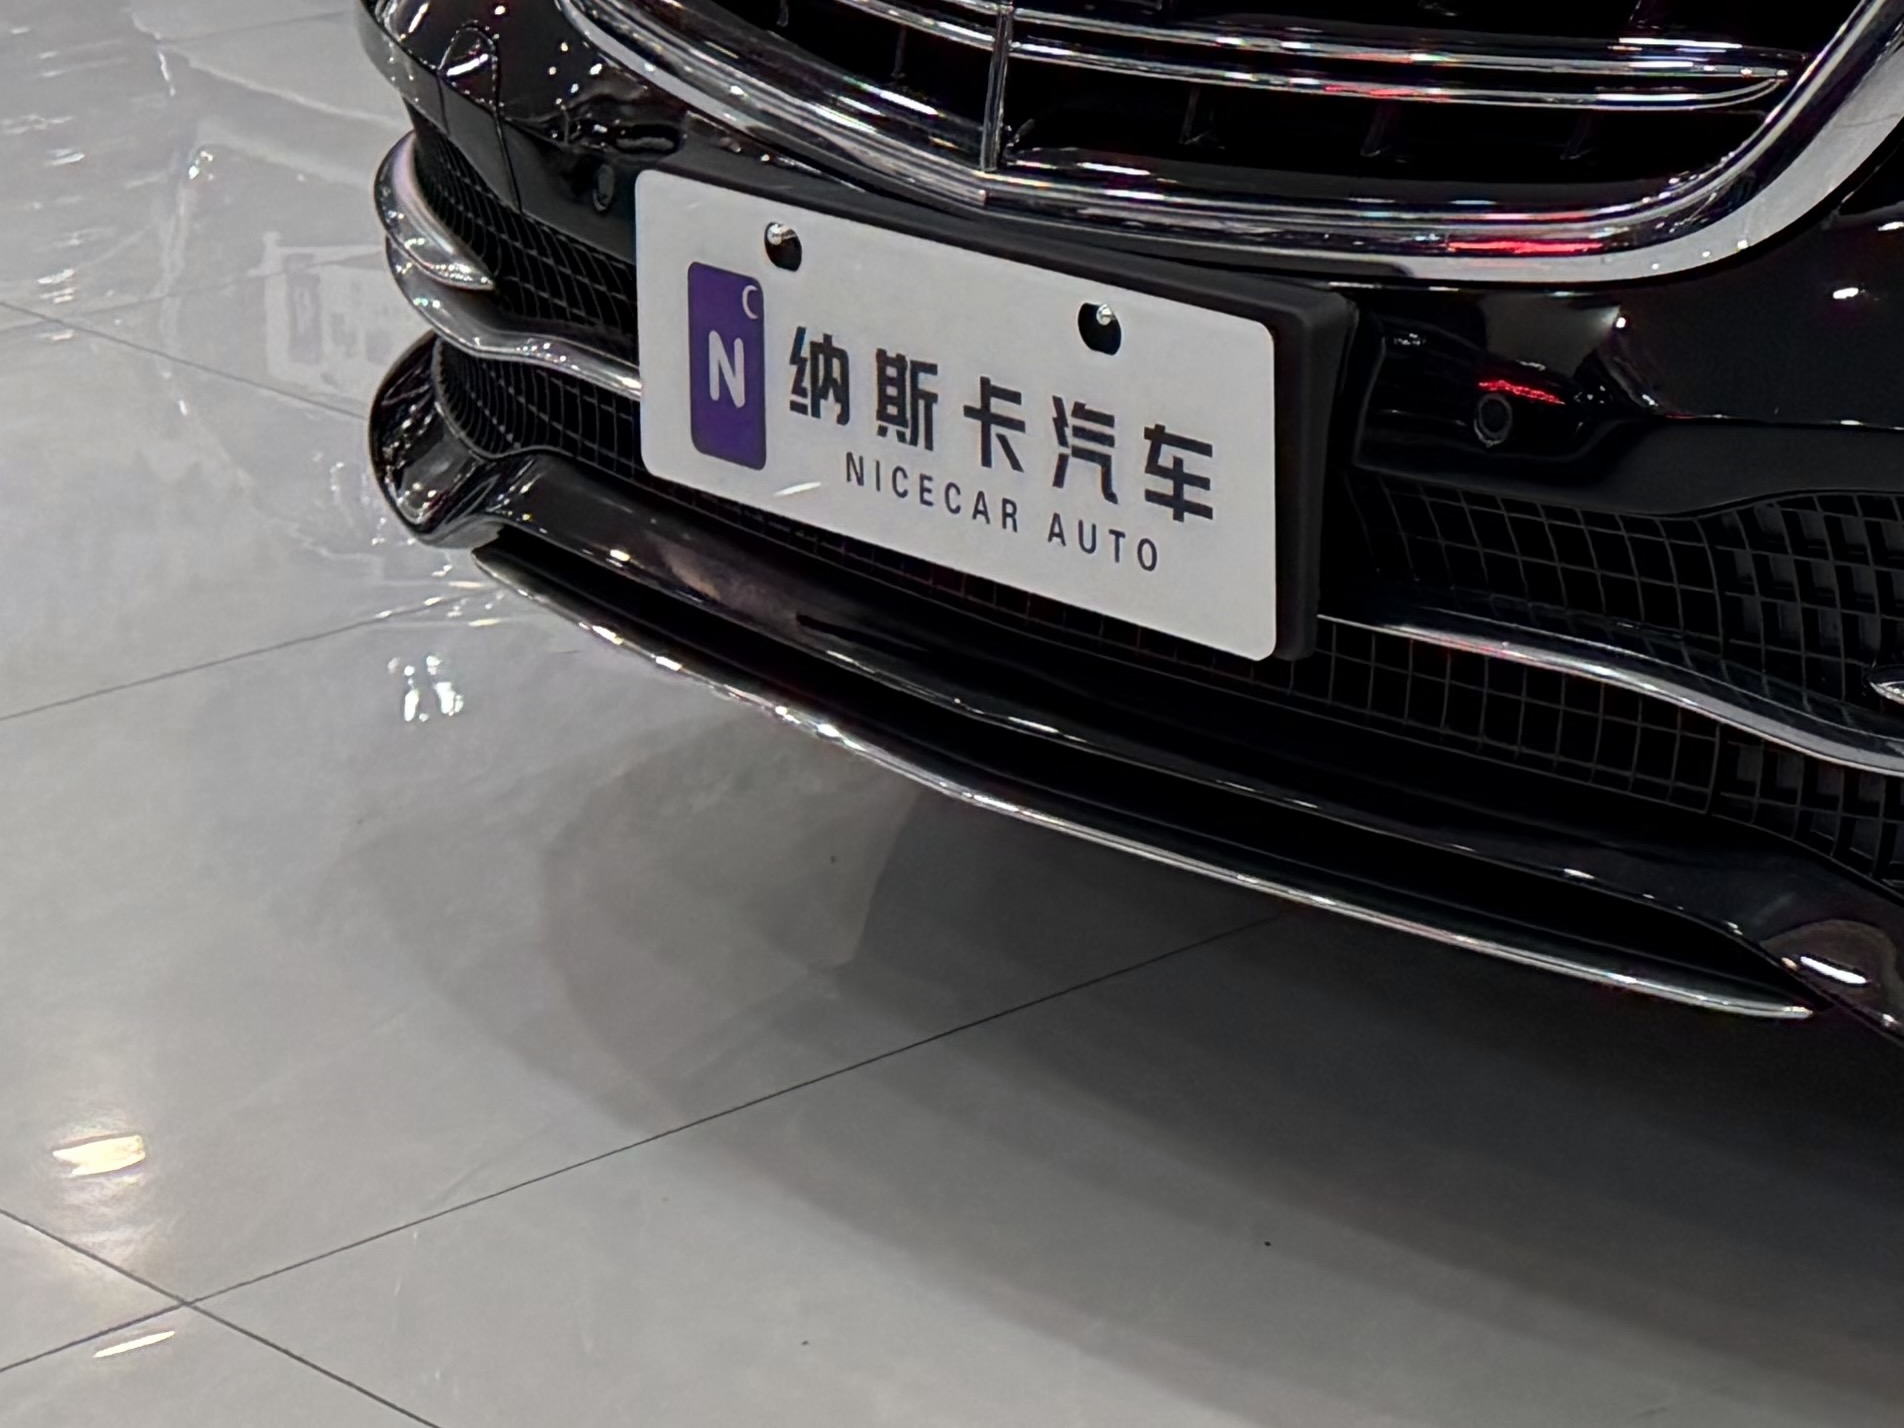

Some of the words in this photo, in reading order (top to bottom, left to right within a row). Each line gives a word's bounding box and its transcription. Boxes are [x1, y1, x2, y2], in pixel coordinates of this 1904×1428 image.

[708, 330, 746, 410] N
[788, 325, 1214, 524] 纳斯卡汽车
[845, 451, 1019, 534] NICECAR
[1047, 512, 1159, 573] AUTO
